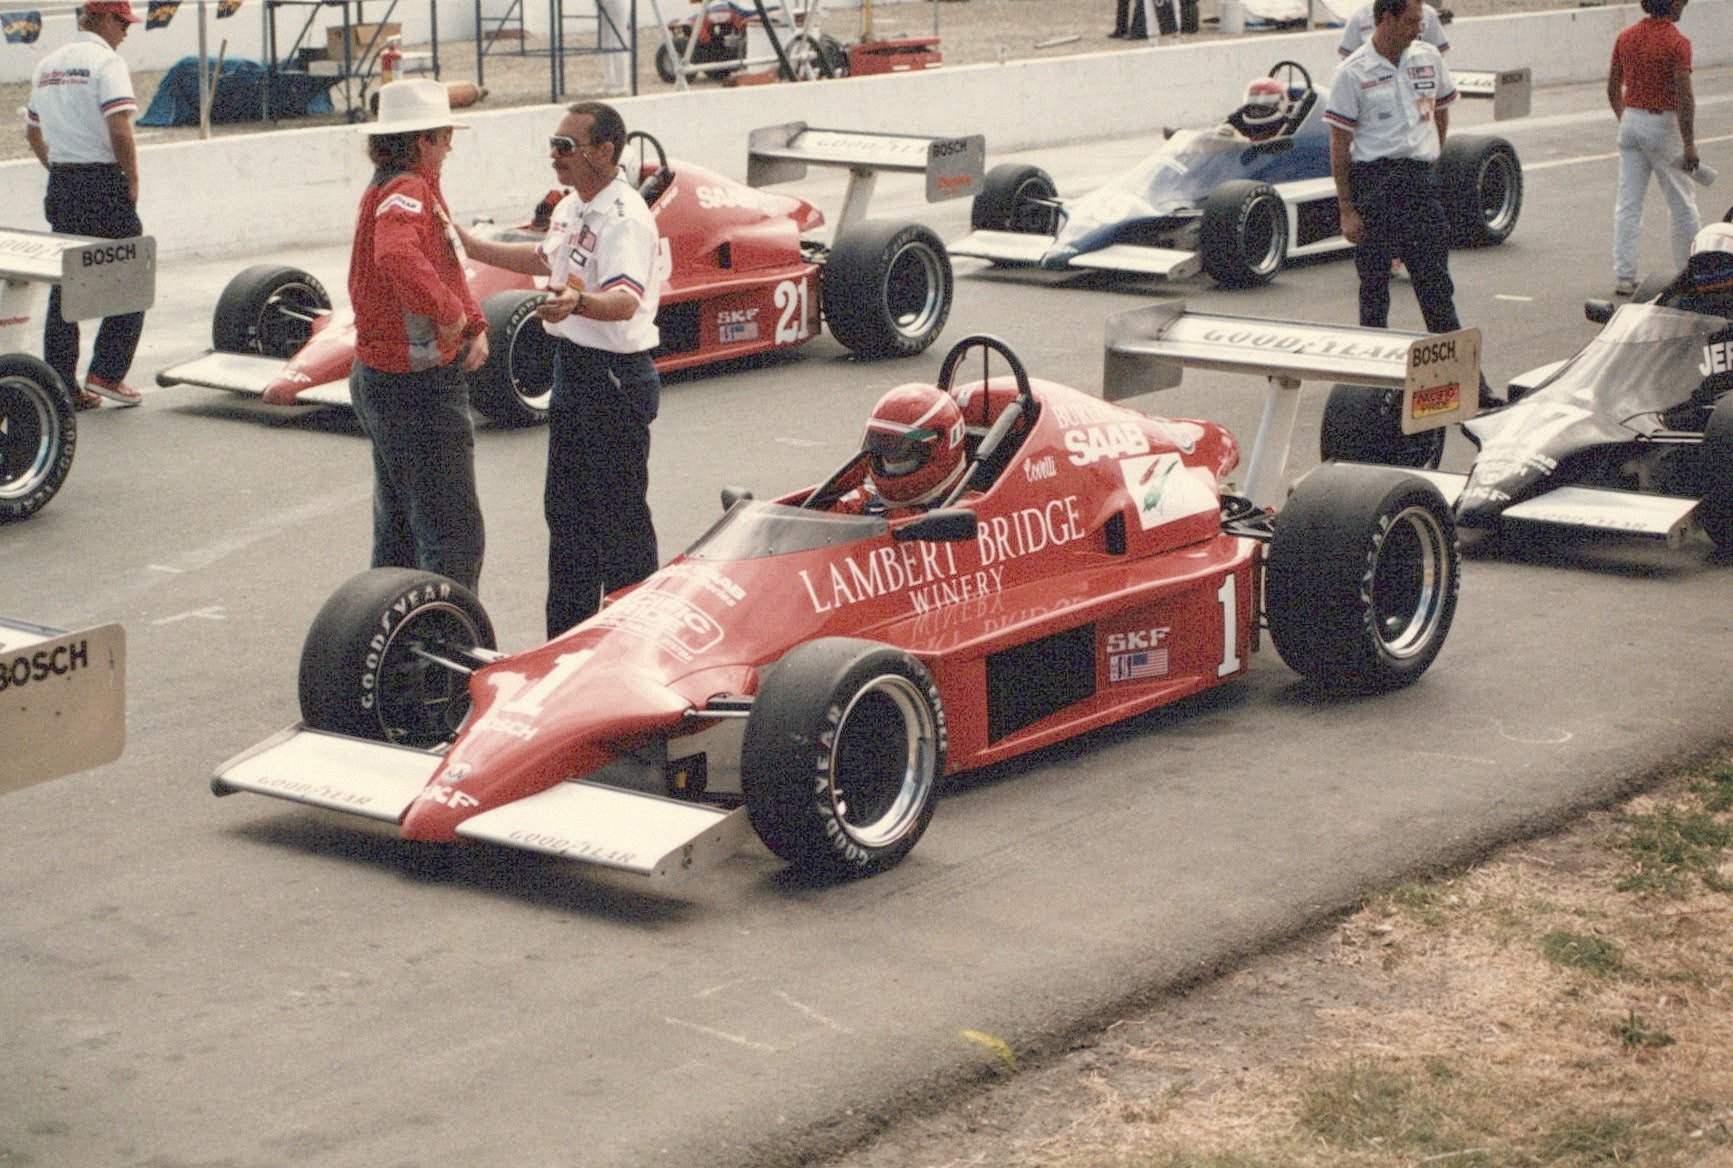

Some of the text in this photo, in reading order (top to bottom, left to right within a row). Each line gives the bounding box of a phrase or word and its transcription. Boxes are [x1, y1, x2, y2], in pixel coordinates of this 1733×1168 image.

[932, 140, 967, 157] BOSCH
[82, 243, 137, 267] BOSCH
[718, 307, 760, 324] SKF
[774, 276, 809, 345] 21
[1412, 340, 1456, 368] BOSCH
[1064, 422, 1150, 467] SAAB
[798, 494, 1086, 614] LAMBERT BRIDGE
[907, 565, 1005, 615] WINERY
[1106, 626, 1170, 653] SKF
[1217, 572, 1241, 678] 1
